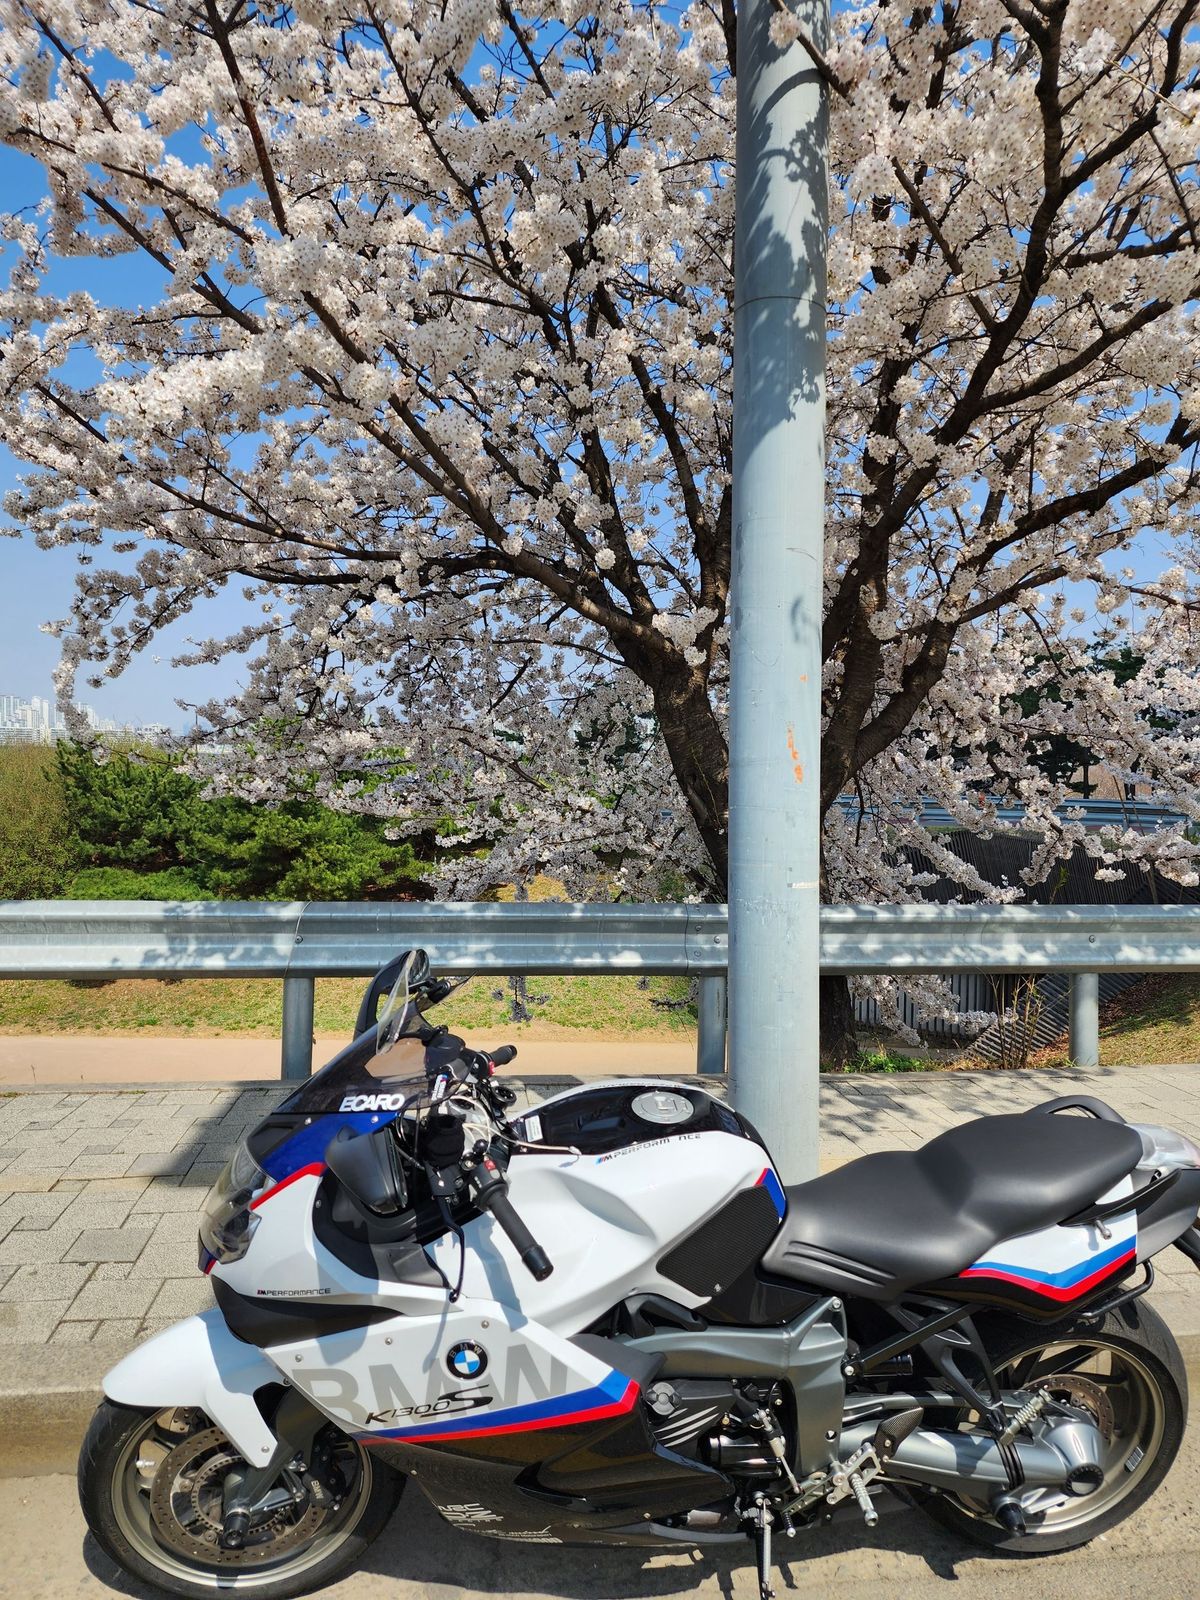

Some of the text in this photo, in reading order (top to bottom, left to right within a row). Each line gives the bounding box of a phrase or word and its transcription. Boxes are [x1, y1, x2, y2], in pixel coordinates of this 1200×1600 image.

[448, 1343, 483, 1358] BMW
[292, 1344, 568, 1429] BMW
[311, 1480, 324, 1499] BMW
